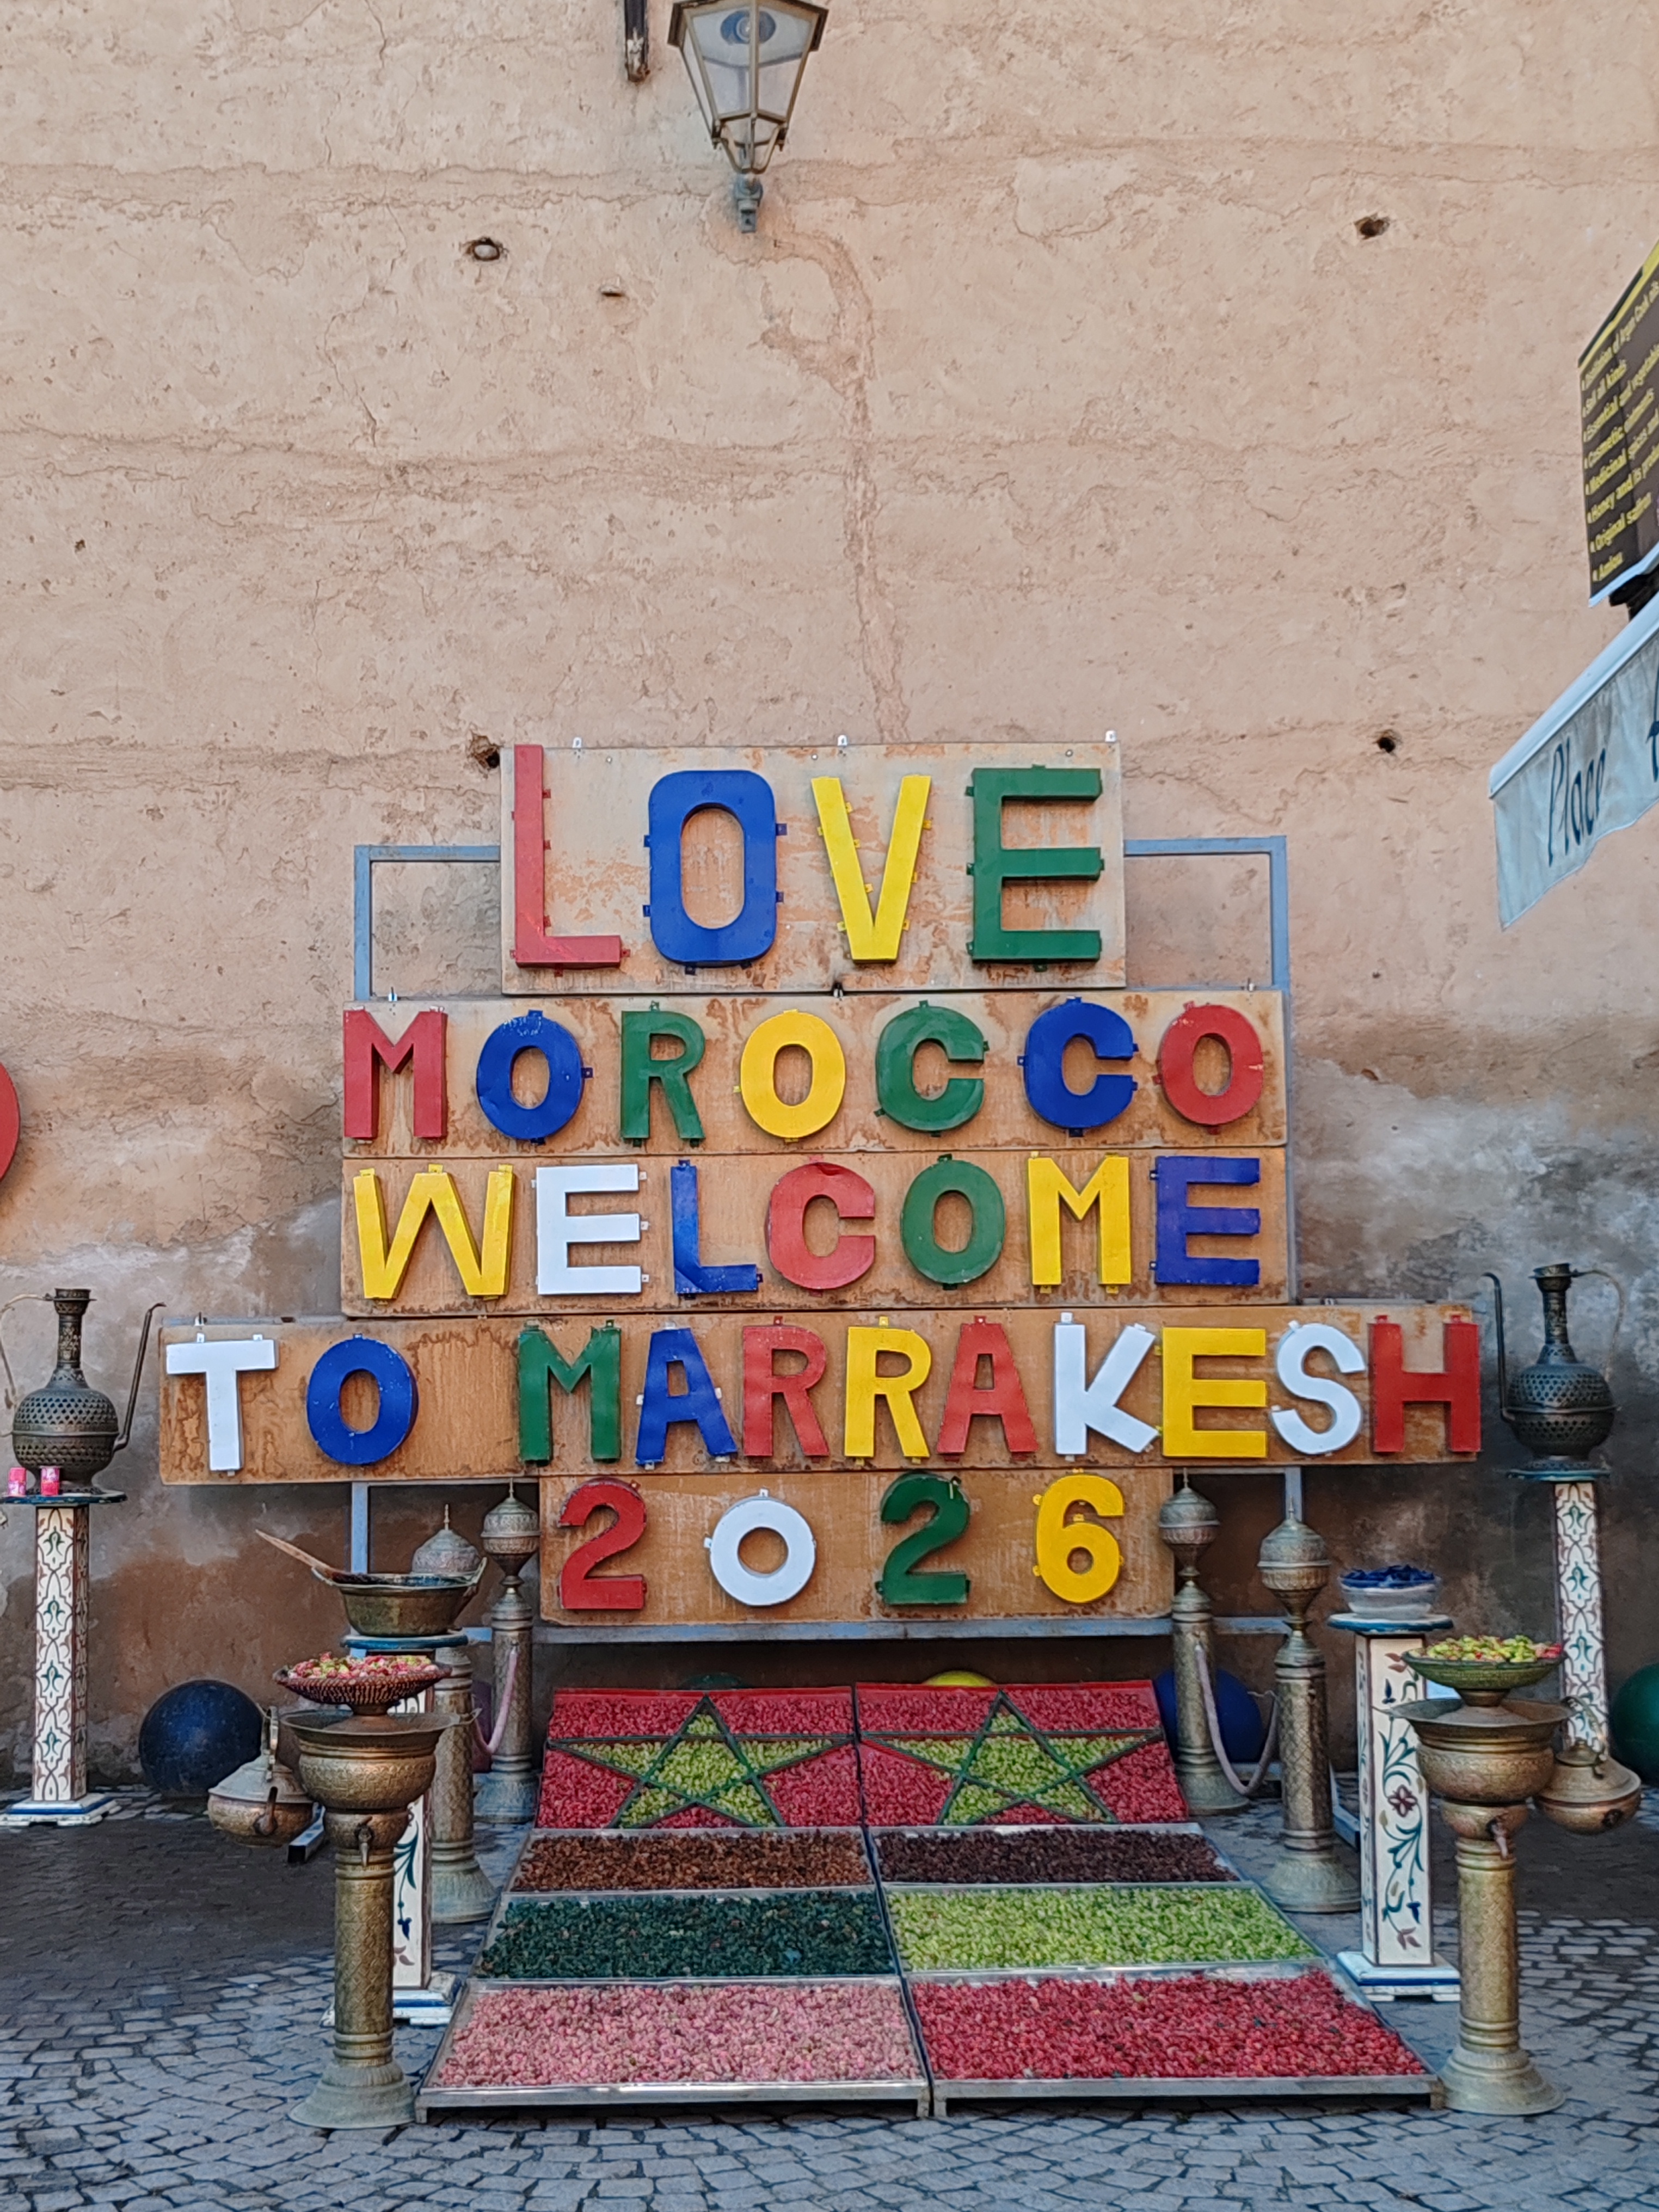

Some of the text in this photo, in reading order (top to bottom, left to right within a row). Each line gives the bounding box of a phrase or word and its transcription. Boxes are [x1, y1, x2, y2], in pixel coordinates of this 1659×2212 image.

[514, 745, 1102, 967] LOVE
[344, 1001, 1263, 1141] MOROCCO
[353, 1156, 1261, 1299] WELCOME
[166, 1323, 1481, 1471] TO MARRAKESH
[558, 1471, 1123, 1606] 2026
